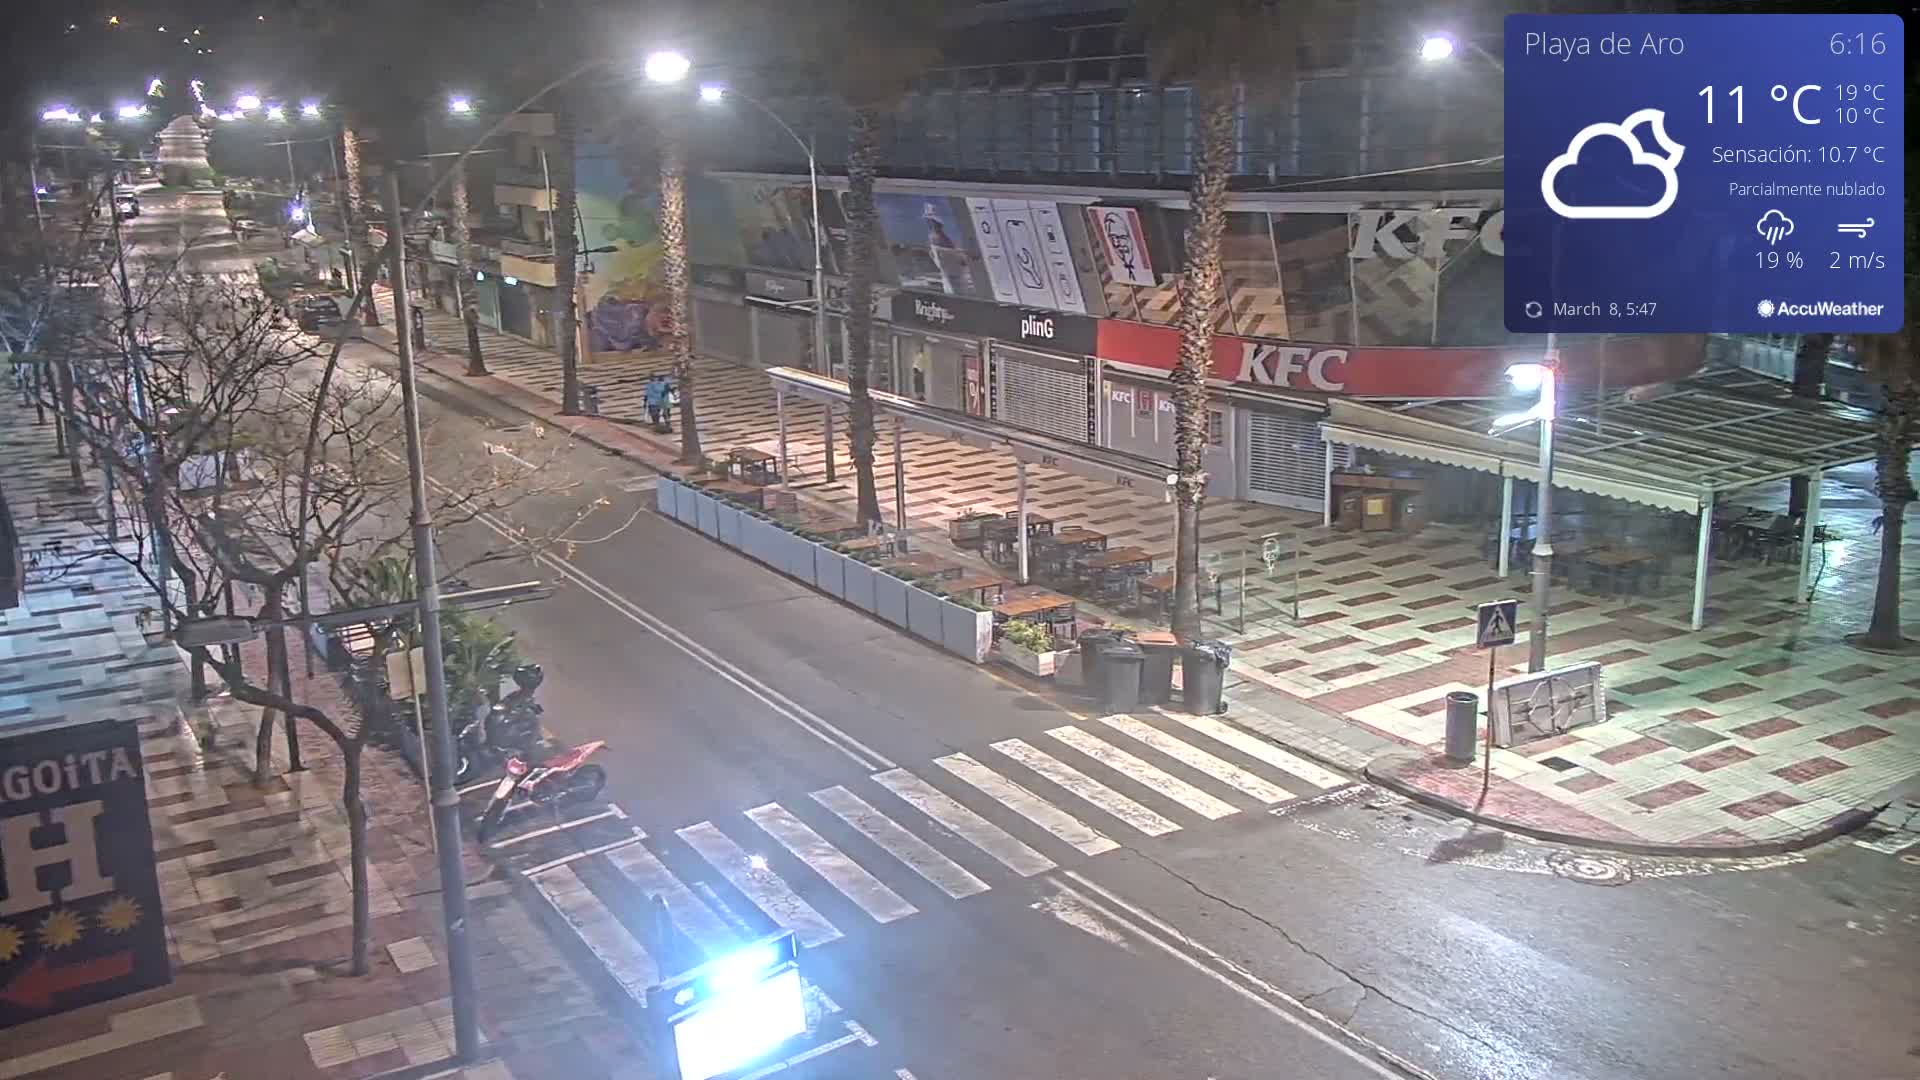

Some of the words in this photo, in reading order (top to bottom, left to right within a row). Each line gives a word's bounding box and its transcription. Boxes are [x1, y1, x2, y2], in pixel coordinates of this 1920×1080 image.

[1236, 342, 1348, 391] KFC
[1112, 391, 1131, 404] KFC
[0, 746, 138, 801] GOiTA
[0, 799, 115, 916] H
